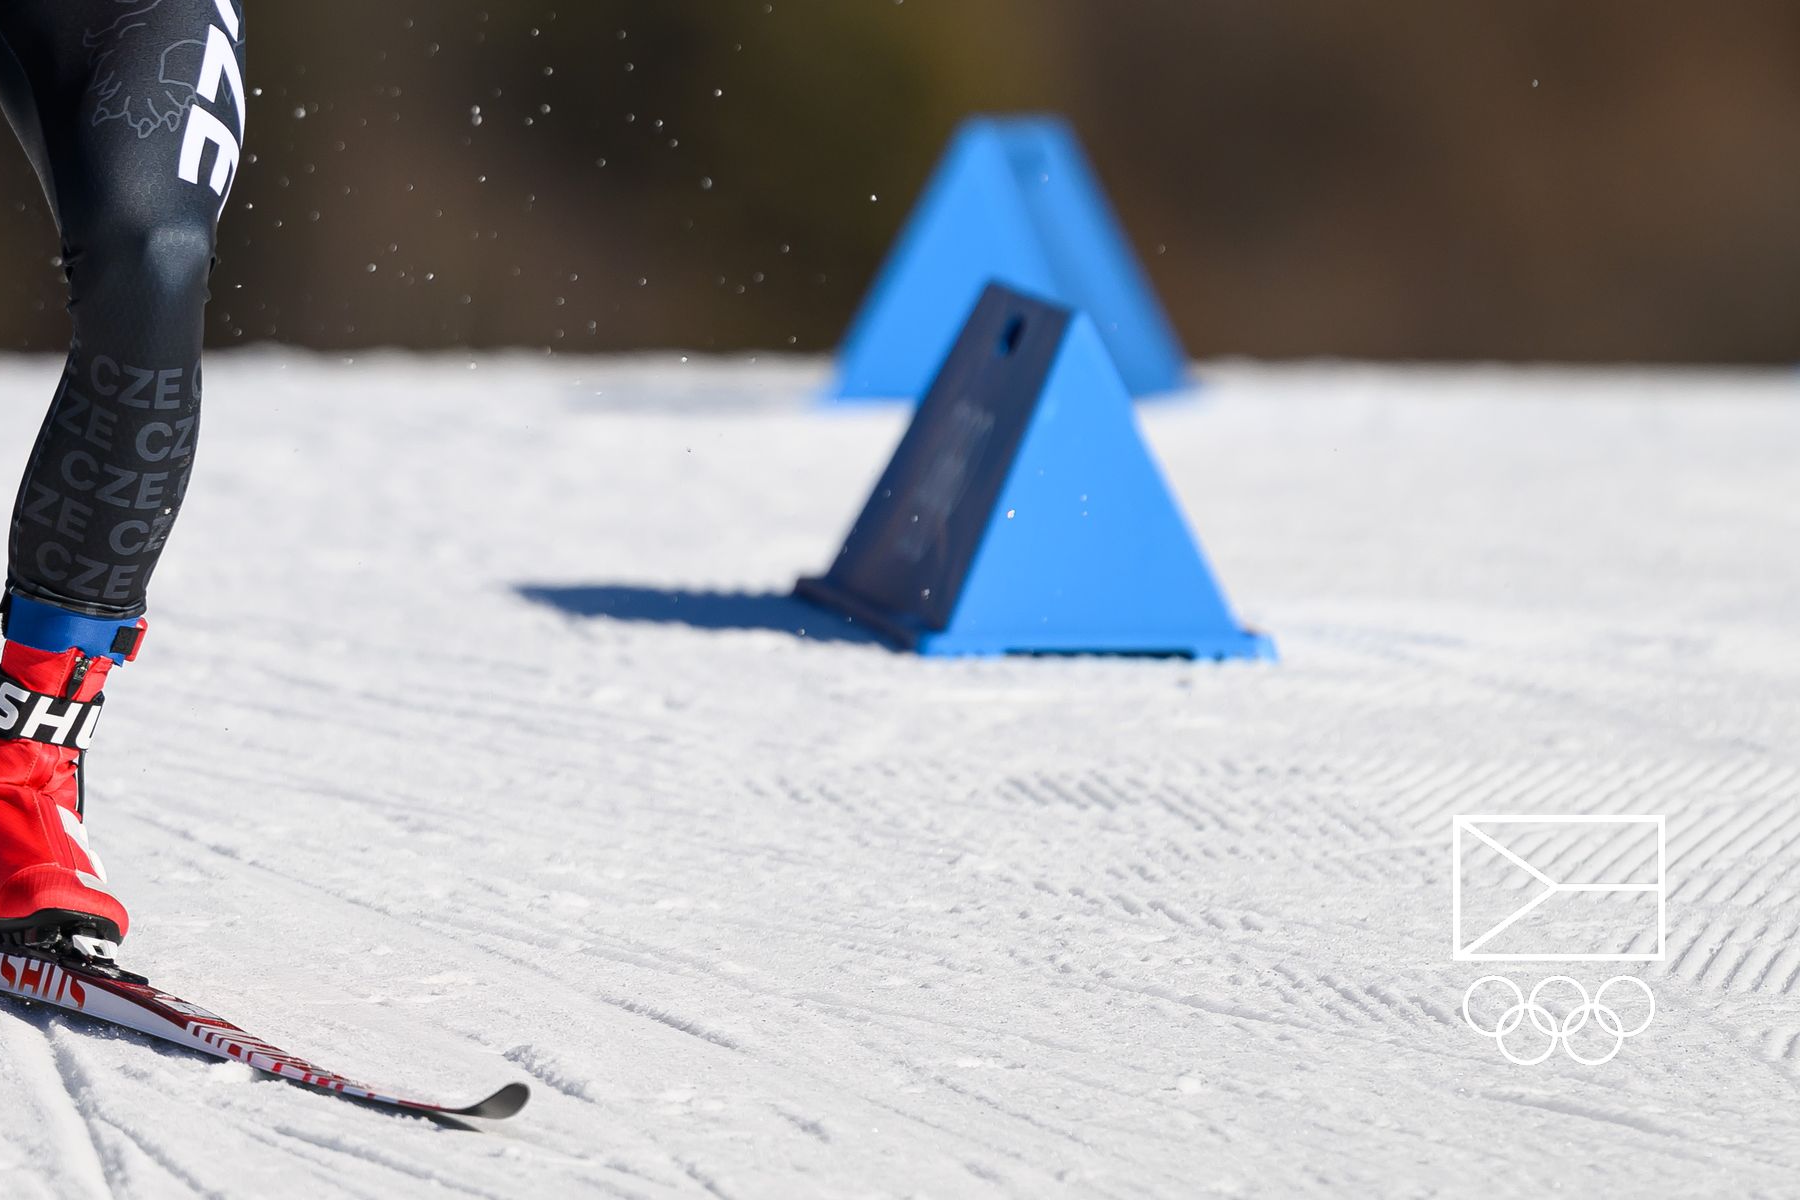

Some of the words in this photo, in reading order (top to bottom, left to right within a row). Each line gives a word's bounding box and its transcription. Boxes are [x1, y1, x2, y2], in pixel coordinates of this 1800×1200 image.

[90, 354, 183, 410] CZE
[135, 412, 200, 462] CZ
[60, 450, 169, 510] CZE
[36, 541, 140, 599] CZE
